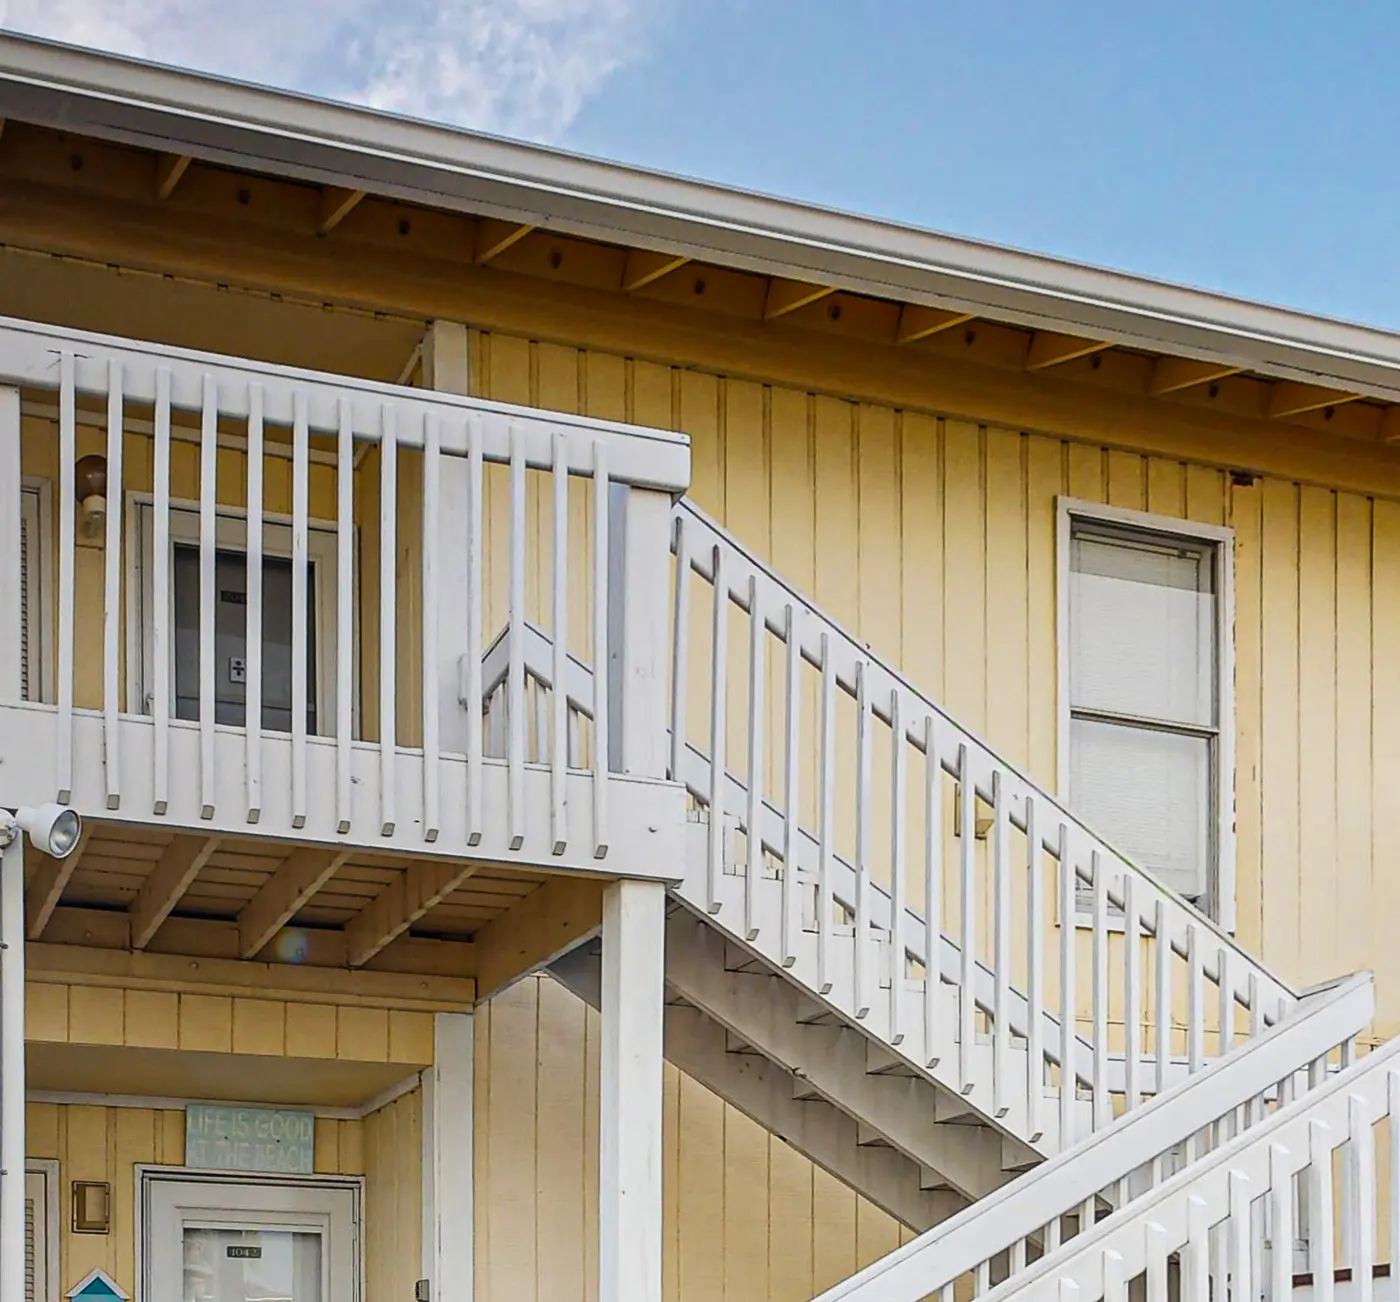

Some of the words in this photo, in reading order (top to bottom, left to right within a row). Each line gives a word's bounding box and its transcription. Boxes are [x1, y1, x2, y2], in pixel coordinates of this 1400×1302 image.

[188, 1108, 226, 1136] LIFE
[232, 1110, 250, 1139] IS
[255, 1113, 312, 1142] GOOD
